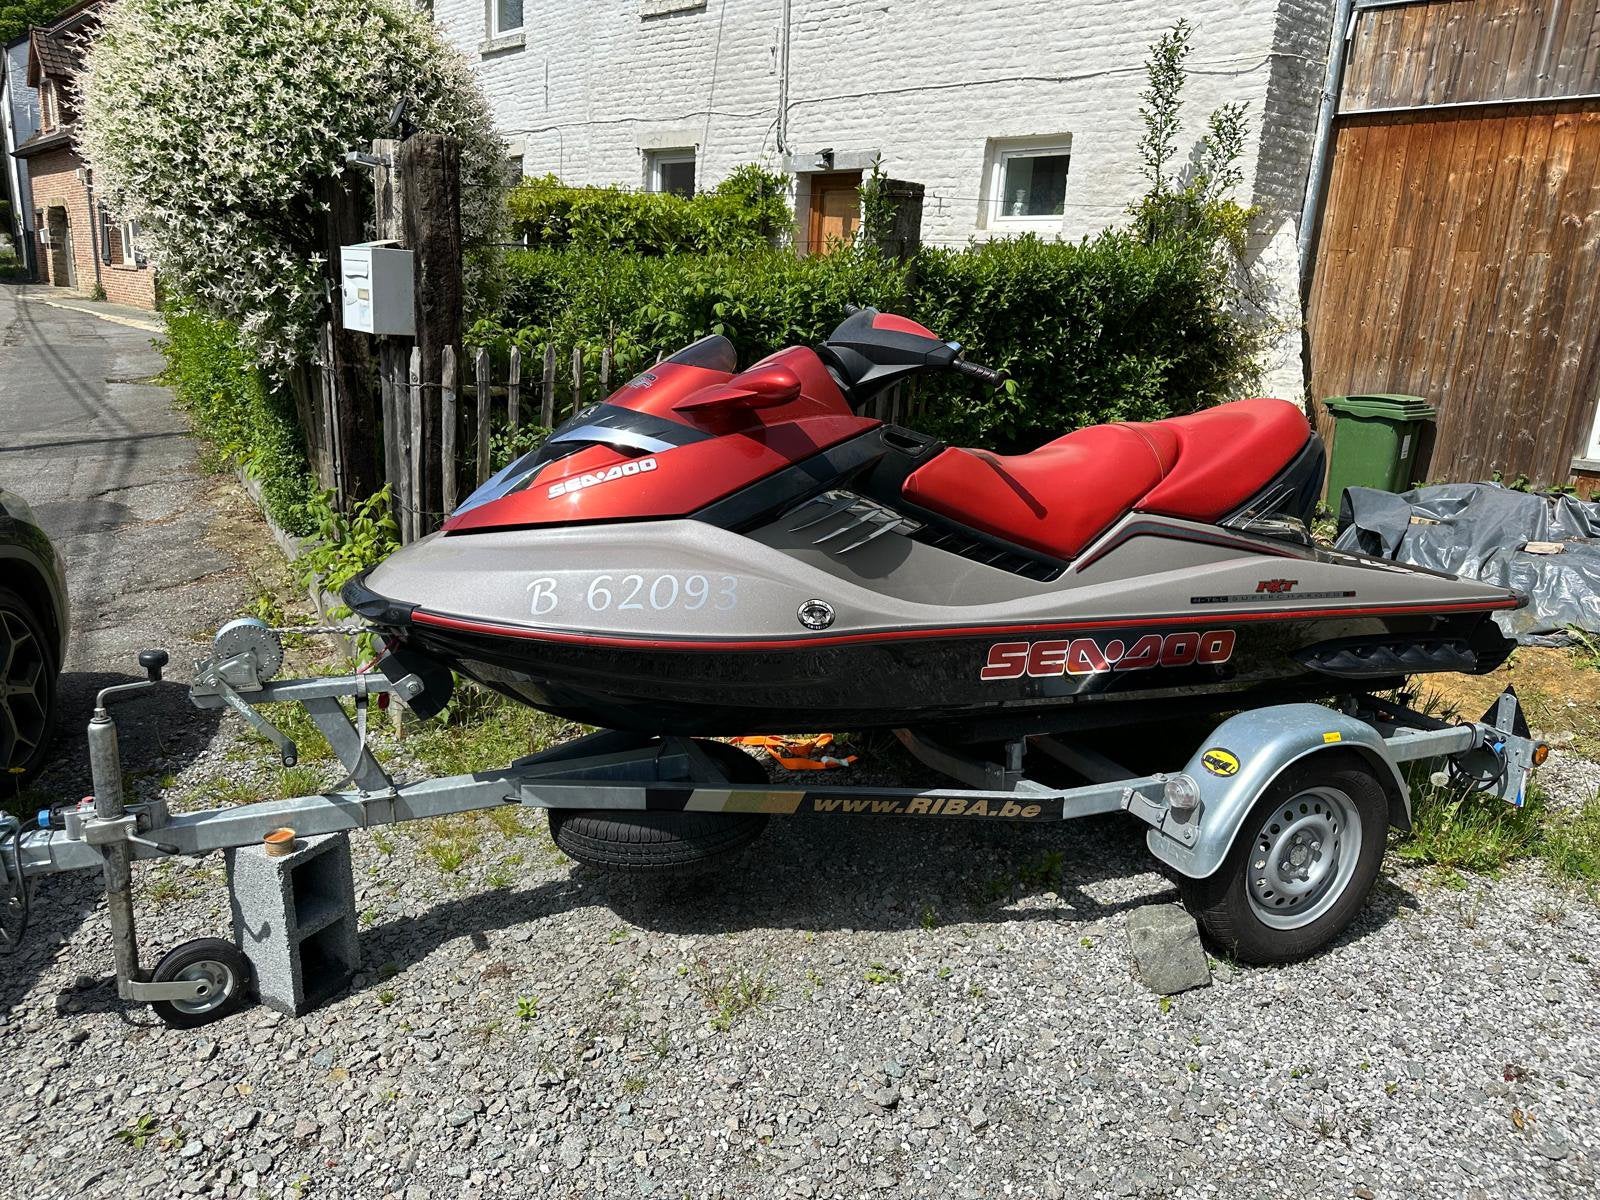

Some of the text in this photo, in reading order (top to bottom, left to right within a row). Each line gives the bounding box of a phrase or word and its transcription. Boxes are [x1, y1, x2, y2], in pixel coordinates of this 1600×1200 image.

[526, 574, 738, 615] B 62093
[813, 797, 1041, 818] www.RIBA.be
